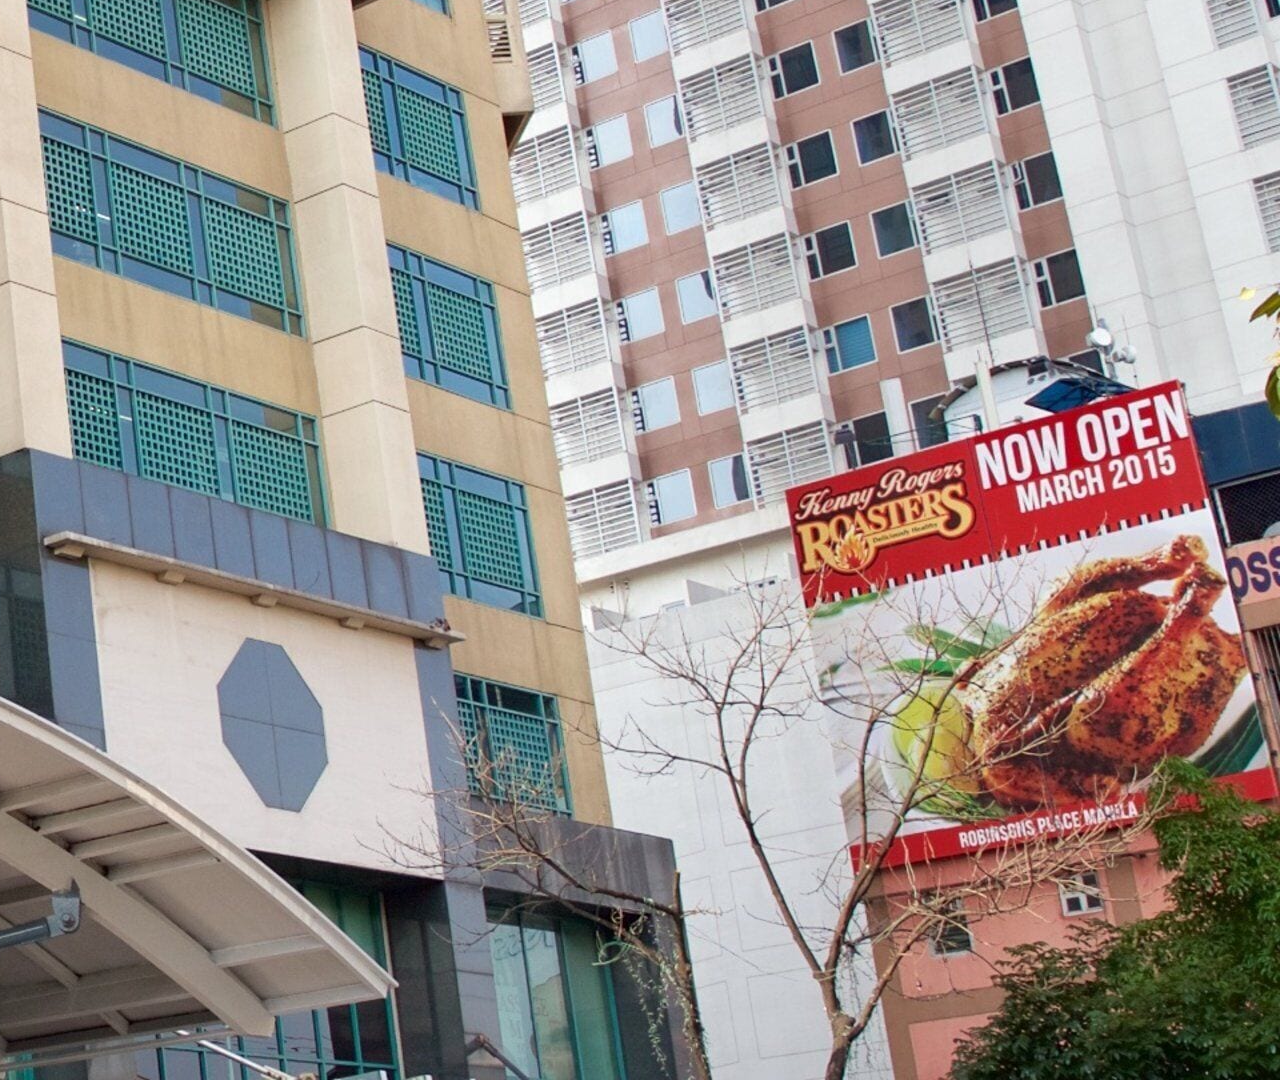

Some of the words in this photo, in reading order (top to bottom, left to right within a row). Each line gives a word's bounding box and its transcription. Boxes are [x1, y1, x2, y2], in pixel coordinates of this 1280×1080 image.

[975, 422, 1067, 489] NOW
[1076, 390, 1189, 462] OPEN
[795, 487, 874, 520] Kenny
[877, 462, 963, 498] Rogers
[1016, 464, 1105, 513] MARCH
[1109, 446, 1177, 489] 2015
[796, 483, 975, 572] ROASTERS
[958, 819, 1036, 849] ROBINSONS
[1037, 811, 1079, 834] PLACE
